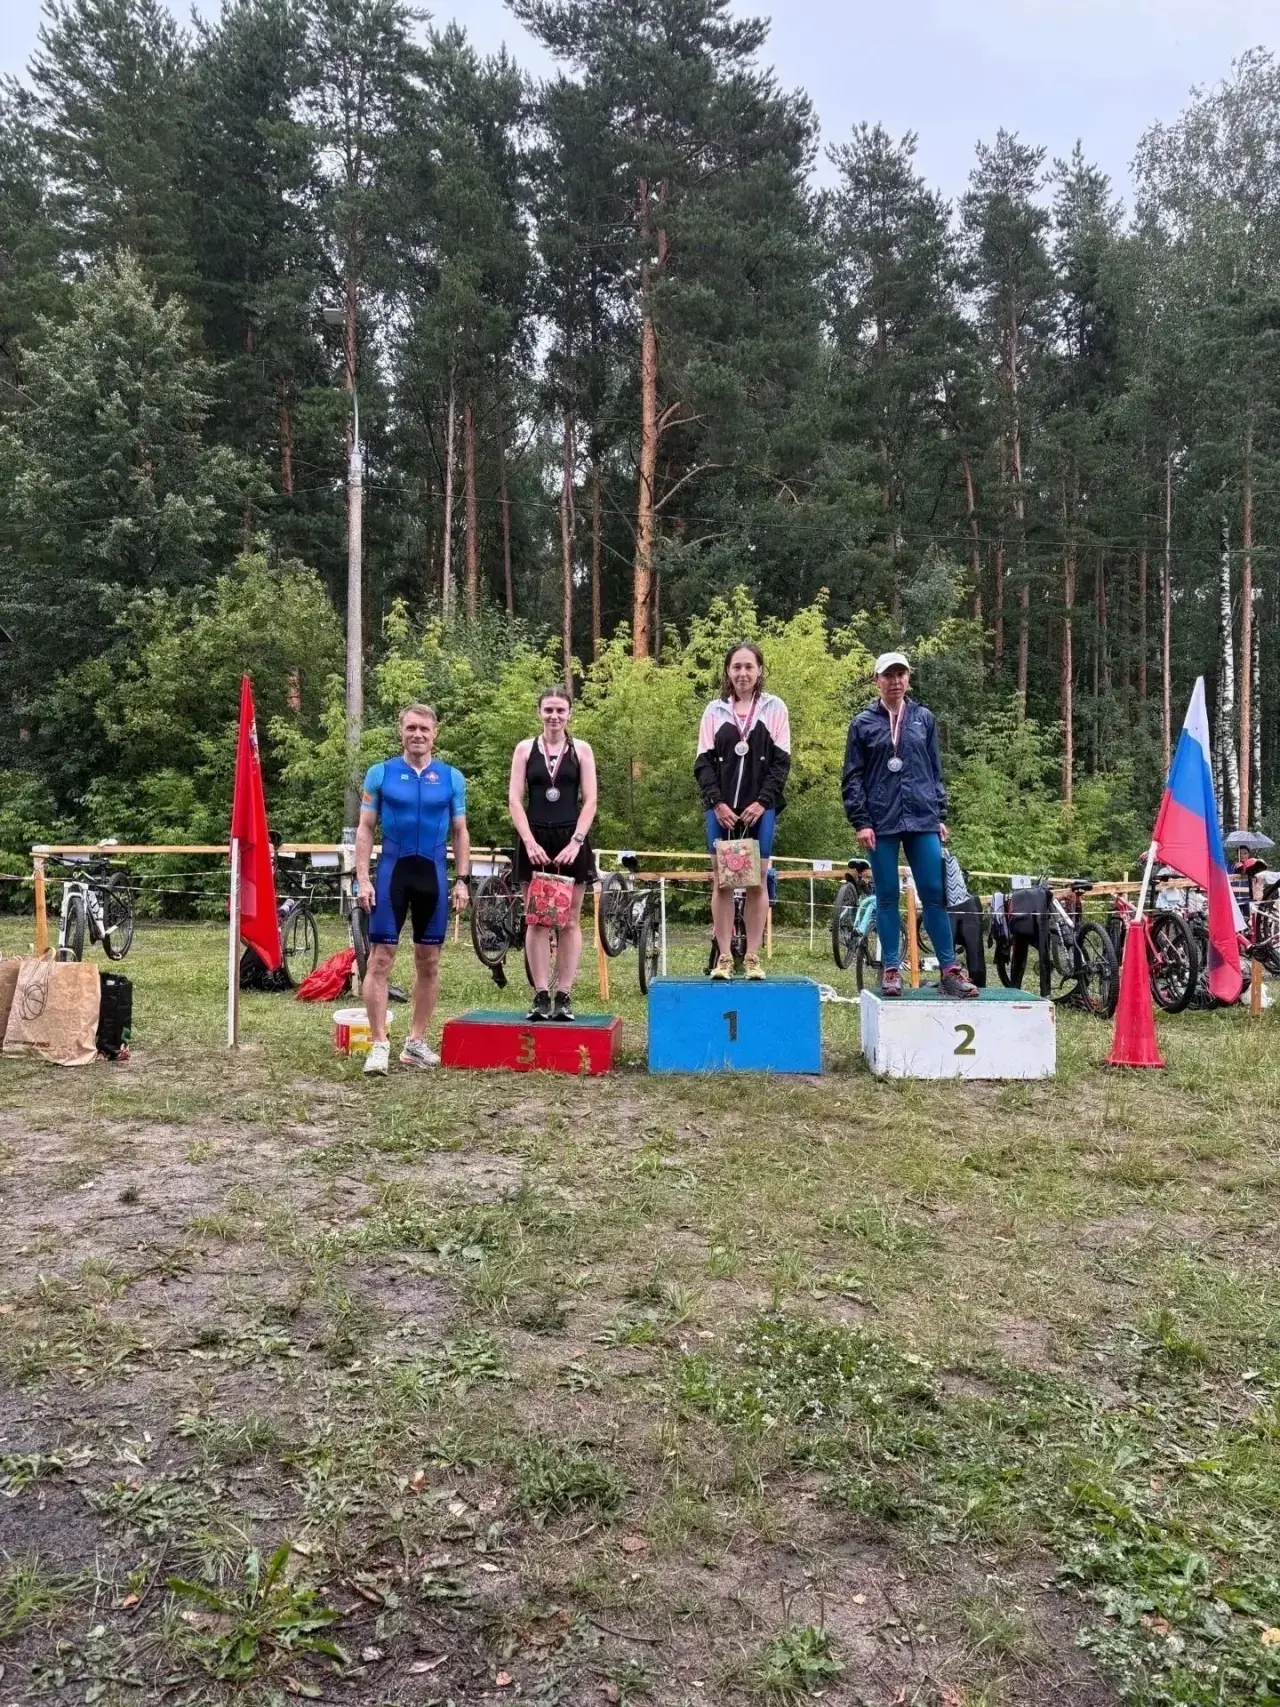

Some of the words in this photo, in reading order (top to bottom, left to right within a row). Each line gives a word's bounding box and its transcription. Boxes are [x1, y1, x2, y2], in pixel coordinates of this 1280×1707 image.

[722, 1010, 738, 1041] 1
[953, 1023, 976, 1056] 2
[516, 1033, 536, 1064] 3
